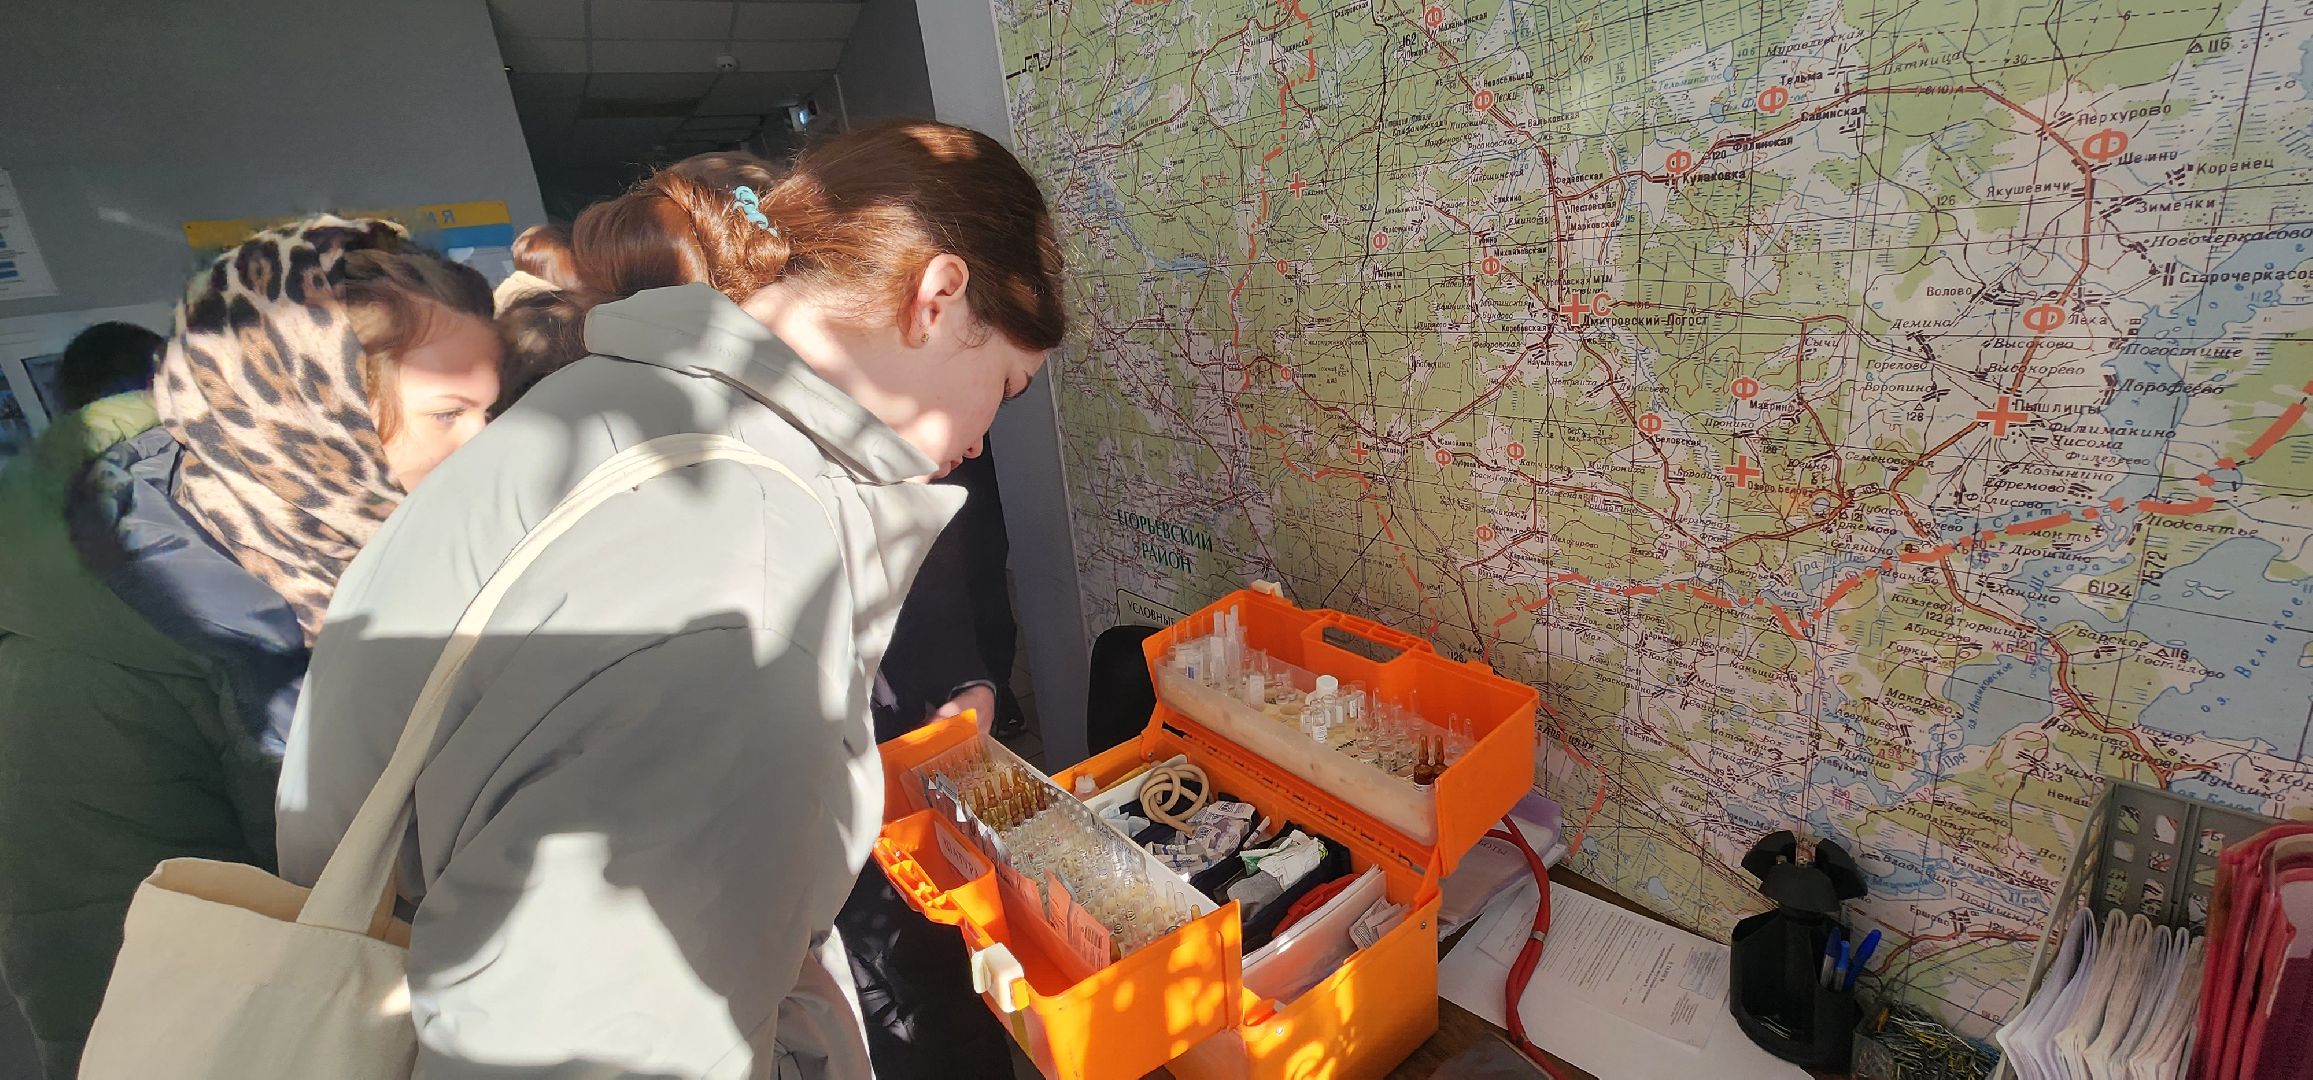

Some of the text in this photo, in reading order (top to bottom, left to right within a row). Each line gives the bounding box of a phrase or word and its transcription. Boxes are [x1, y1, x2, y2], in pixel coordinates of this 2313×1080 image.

[2013, 55, 2028, 64] 30
[1757, 85, 1789, 113] Ф
[1800, 105, 1867, 122] Савинская
[2079, 103, 2172, 126] Перхурово
[2082, 128, 2129, 163] Ф
[1665, 148, 1692, 174] Ф
[2196, 159, 2274, 177] Коренец
[1682, 169, 1746, 185] Кулаковка
[1986, 182, 2071, 198] Якушевичи
[2137, 199, 2215, 213] Зименки
[2149, 227, 2313, 248] Новочеркасово
[1926, 286, 1972, 297] Волово
[1592, 292, 1613, 317] С
[2022, 302, 2066, 334] Ф
[2068, 315, 2108, 326] Лека
[1805, 336, 1839, 349] Сычи
[1993, 338, 2074, 350] Высоково
[1527, 358, 1573, 367] Наумовская
[1866, 359, 1928, 371] Горелово
[1988, 362, 2086, 376] Высокорево
[1731, 376, 1759, 400] Ф
[1864, 381, 1932, 393] Воропино
[1750, 400, 1796, 412] Маврино
[2017, 398, 2105, 415] Пышлицы
[1638, 412, 1662, 434] Ф
[1906, 412, 1924, 422] 128
[2052, 434, 2124, 450] Чисома
[1983, 477, 2065, 494] Ефремово
[1855, 502, 1918, 519] Дубасово
[1117, 508, 1213, 554] ЕГОРЬЕВСКИЙ
[1141, 541, 1192, 575] РАЙОН
[2088, 579, 2132, 599] 6124
[2077, 628, 2150, 649] Барское
